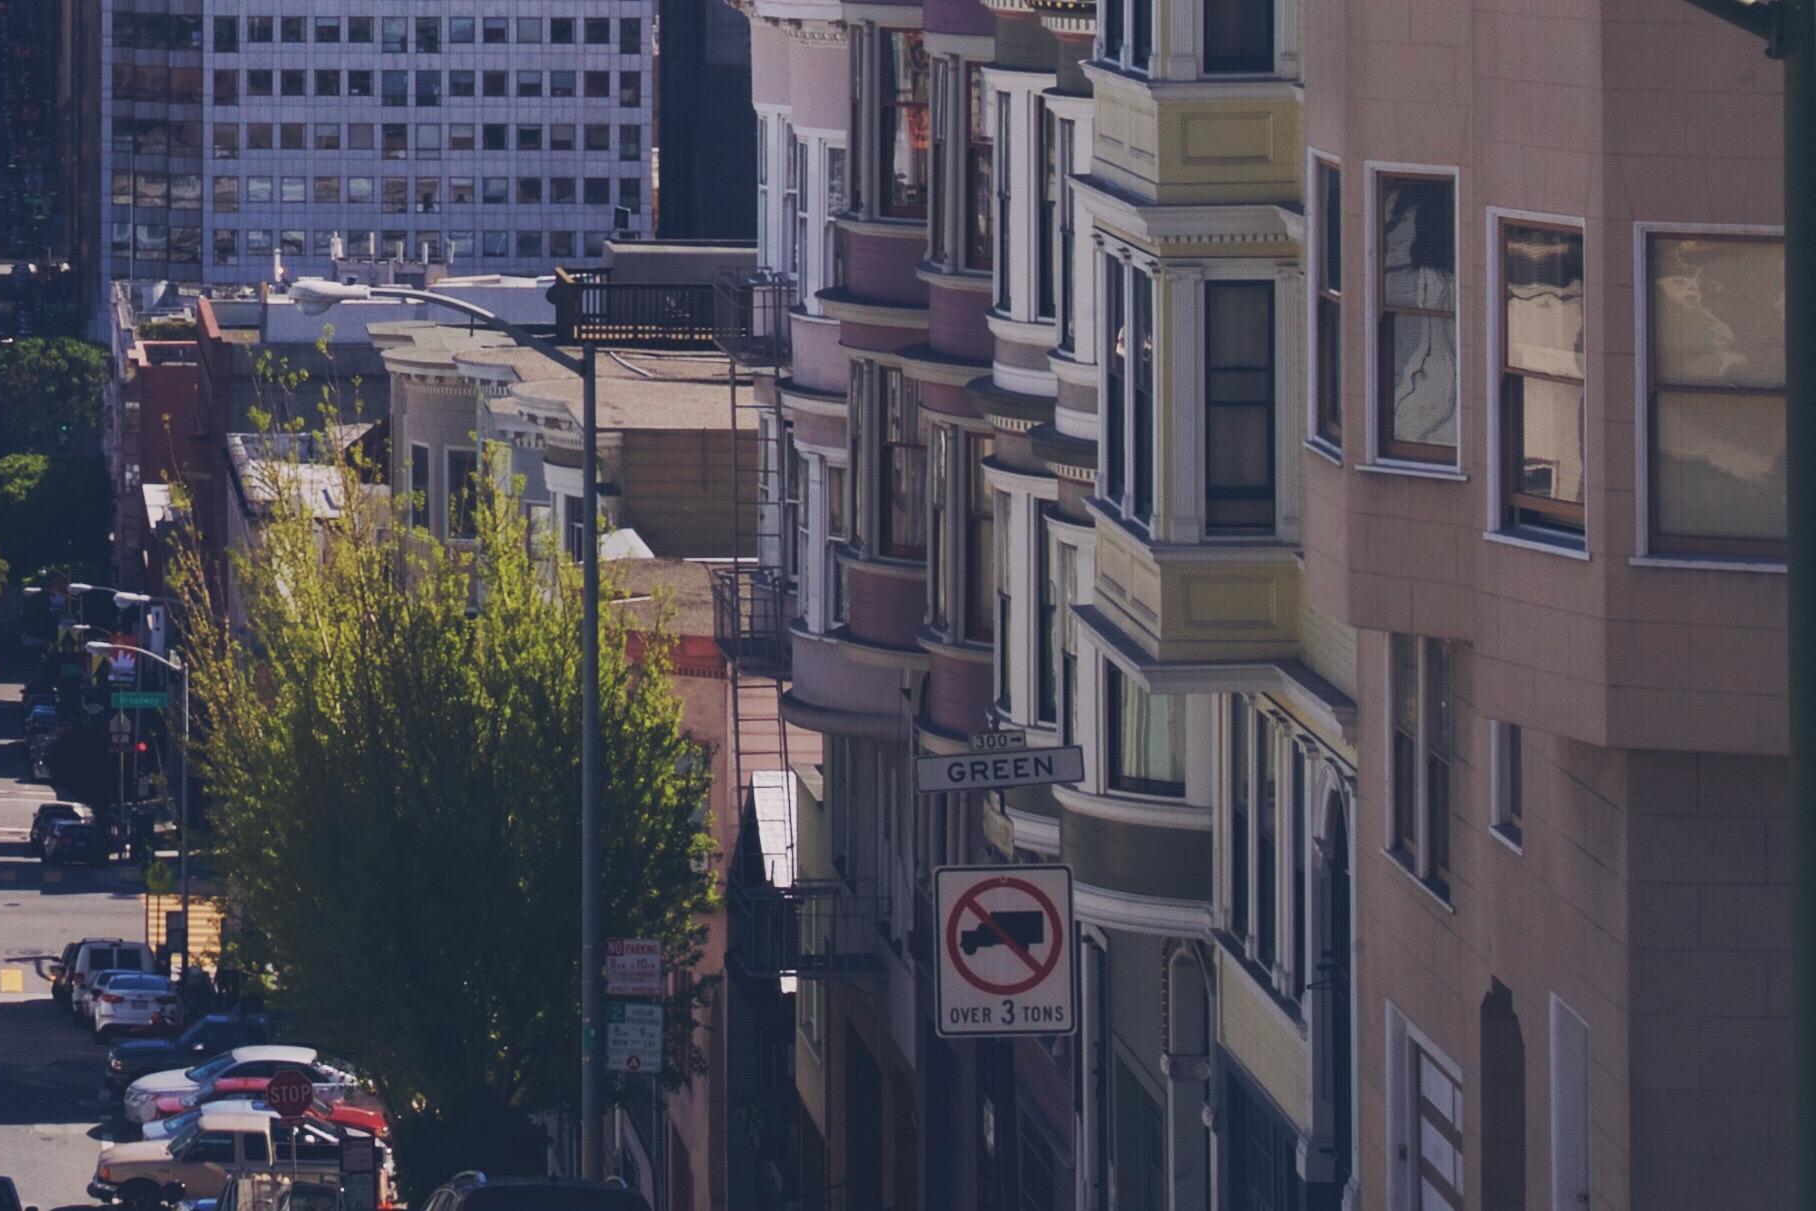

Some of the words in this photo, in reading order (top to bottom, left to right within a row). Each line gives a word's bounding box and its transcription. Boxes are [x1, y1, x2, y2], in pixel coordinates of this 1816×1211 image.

[976, 735, 1007, 748] 300
[947, 756, 1053, 782] GREEN
[608, 941, 622, 954] NO
[611, 1006, 621, 1020] 2
[950, 1007, 991, 1023] OVER
[1001, 999, 1015, 1025] 3
[1022, 1006, 1064, 1022] TONS
[270, 1085, 310, 1103] STOP
